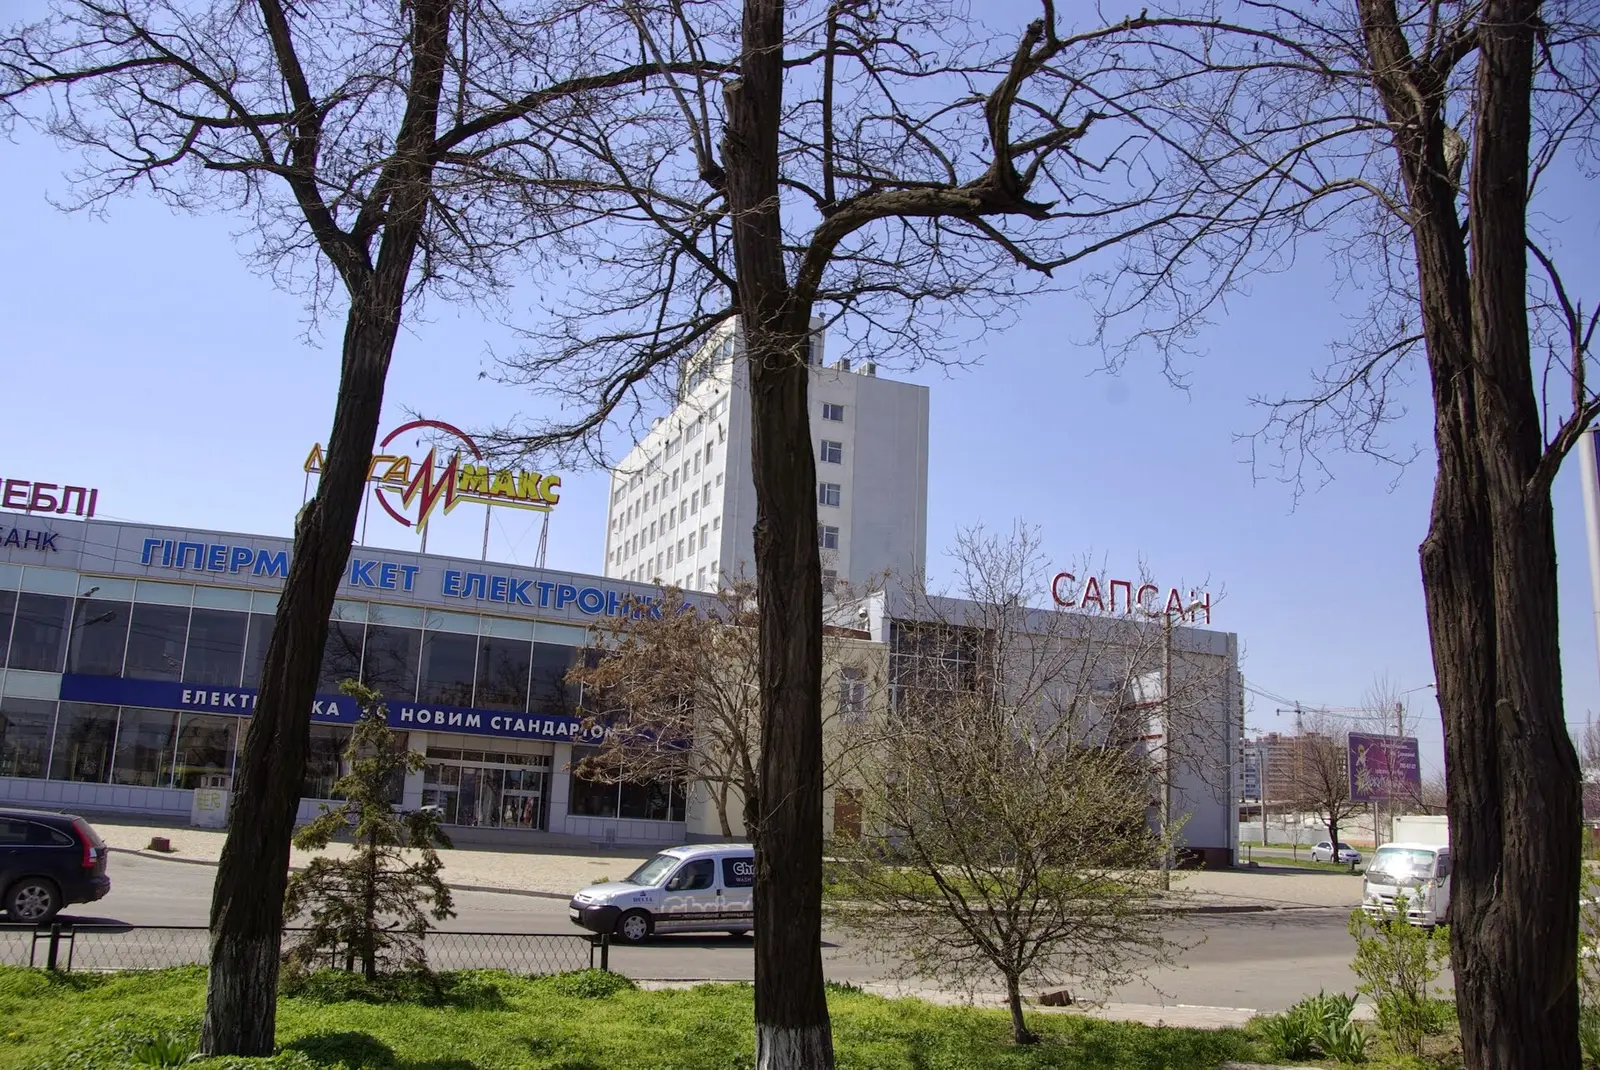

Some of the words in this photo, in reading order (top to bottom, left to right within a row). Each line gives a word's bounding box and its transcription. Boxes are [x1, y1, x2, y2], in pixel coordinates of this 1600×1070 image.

[0, 477, 98, 517] ЕБЛІ
[0, 526, 59, 552] АНК
[140, 537, 421, 592] ГІПЕРМКЕТ
[1051, 572, 1211, 625] САПСАН
[182, 689, 340, 716] ЕЛЕКТКА
[401, 707, 482, 728] НОВИМ
